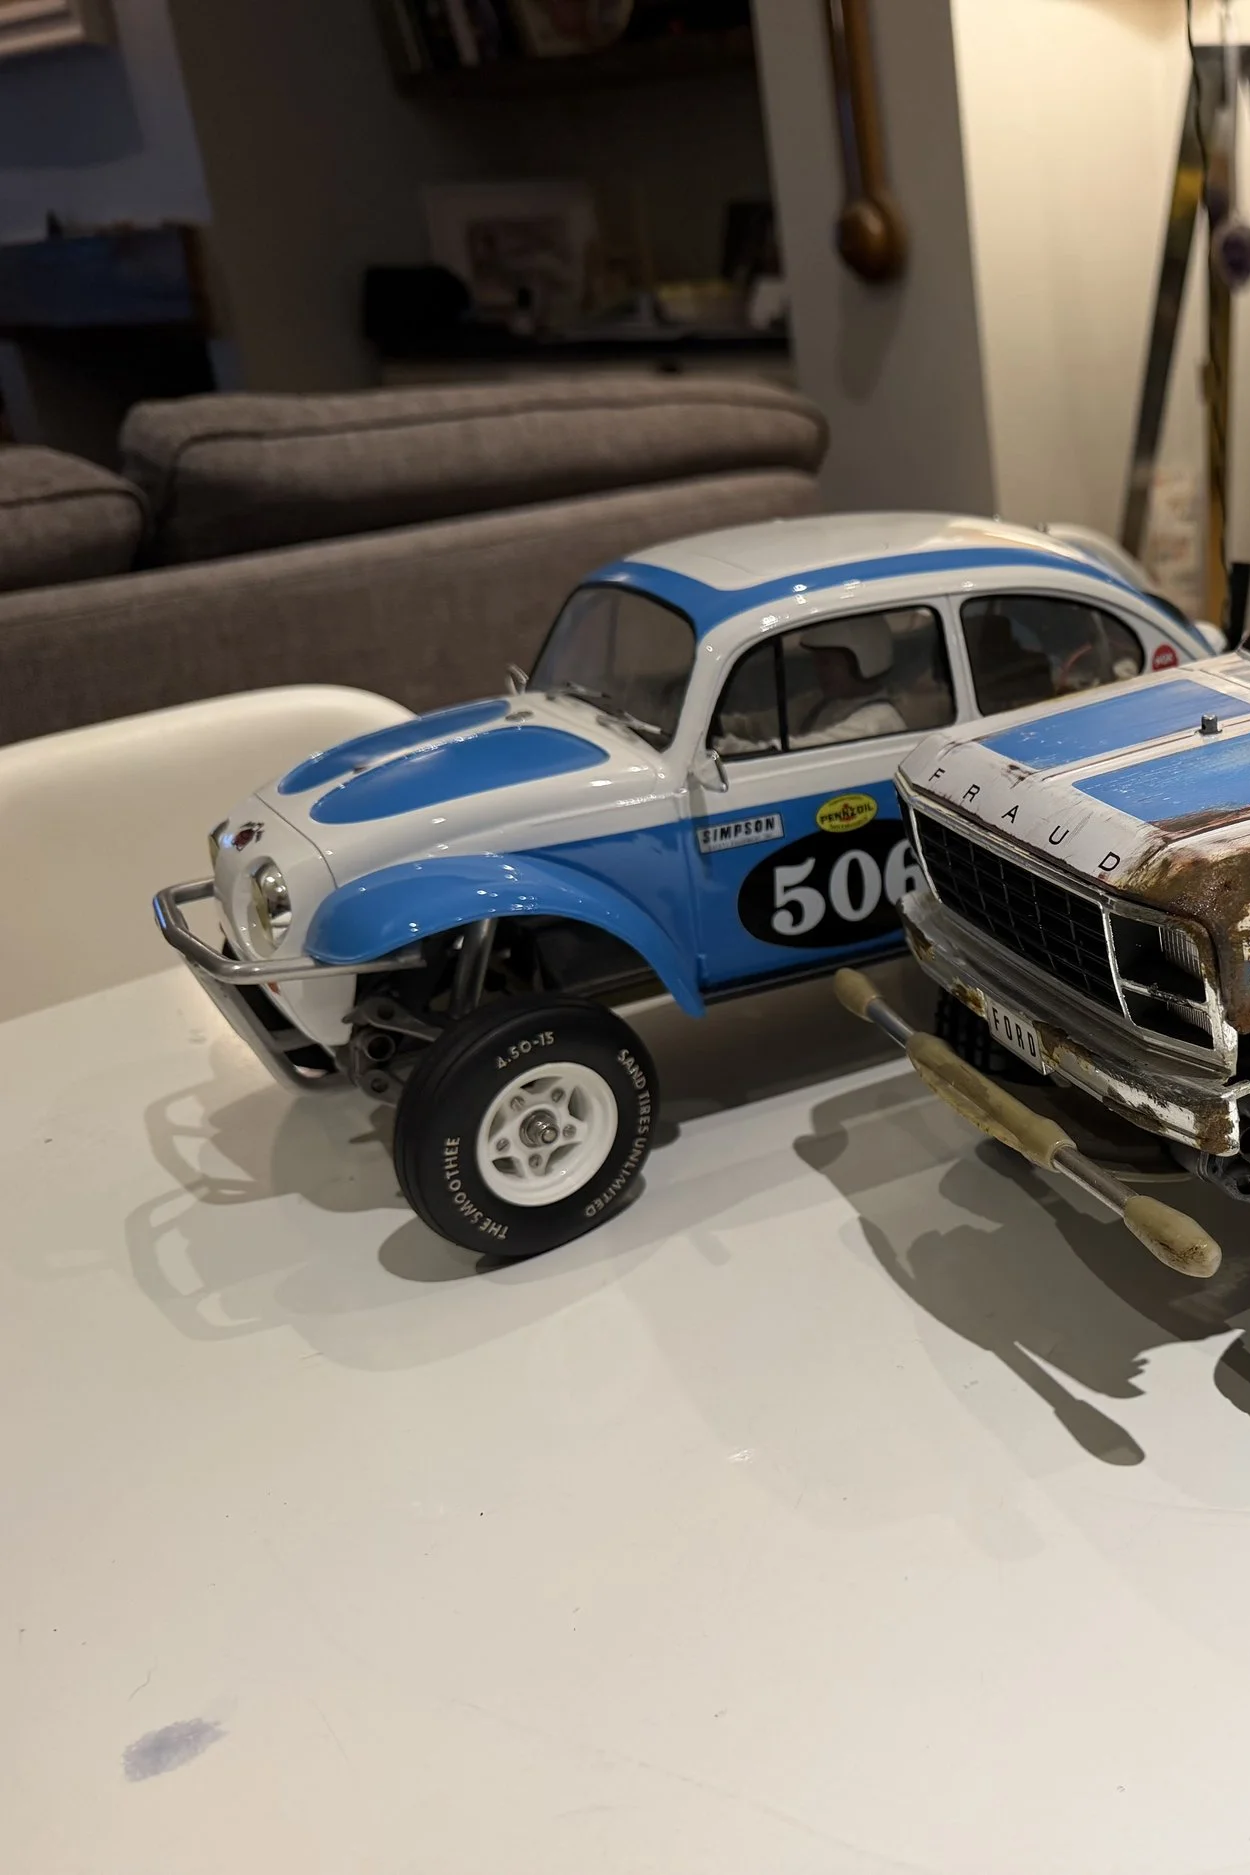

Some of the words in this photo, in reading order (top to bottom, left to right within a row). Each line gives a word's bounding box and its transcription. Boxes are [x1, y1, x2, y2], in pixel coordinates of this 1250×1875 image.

[702, 817, 776, 844] SIMPSON
[820, 802, 875, 824] PENNZOIL
[928, 767, 1121, 873] FRAUD
[496, 1031, 556, 1070] 4.50-15
[992, 1007, 1037, 1058] FORD
[618, 1048, 647, 1090] SAND
[638, 1092, 652, 1135] TIRES
[444, 1135, 483, 1224] SMOOTHEE
[585, 1136, 647, 1218] UNLIMITED
[480, 1218, 510, 1241] THE
